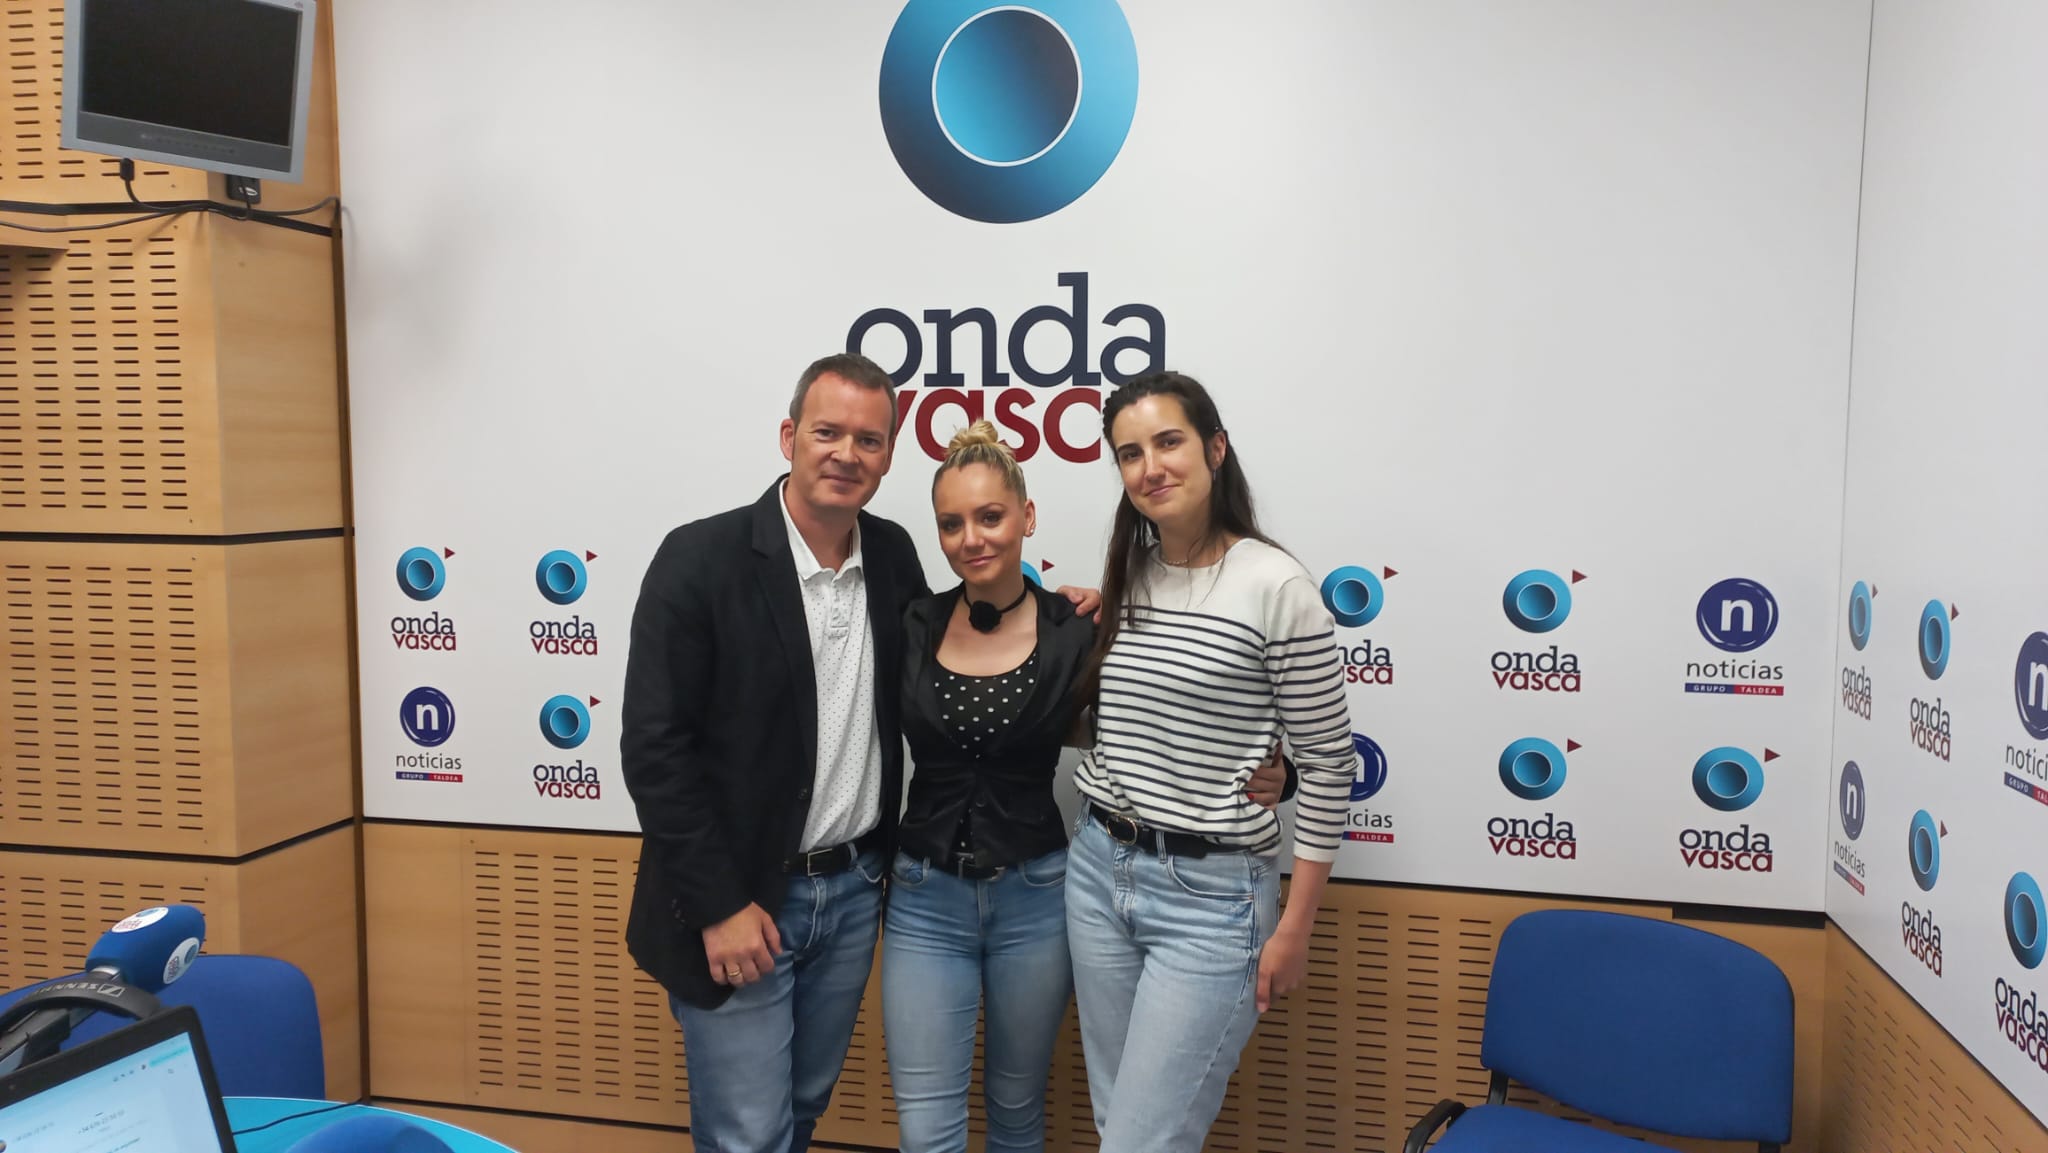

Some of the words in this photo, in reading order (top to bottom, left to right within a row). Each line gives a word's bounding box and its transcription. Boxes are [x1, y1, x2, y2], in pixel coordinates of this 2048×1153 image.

[846, 271, 1167, 388] onda
[891, 387, 1102, 464] asc
[391, 611, 456, 635] onda
[530, 615, 597, 639] onda
[392, 633, 457, 651] vasca
[531, 637, 598, 656] vasca
[1337, 639, 1393, 667] nda
[1491, 645, 1581, 674] onda
[1686, 659, 1784, 681] noticias
[1340, 665, 1393, 685] sca
[1492, 670, 1582, 692] vasca
[1842, 665, 1871, 700] onda
[1693, 684, 1726, 693] GRUPO
[1740, 686, 1777, 695] TALDEA
[1842, 688, 1871, 720] vasca
[1910, 697, 1951, 738] onda
[1910, 720, 1951, 762] vasca
[396, 752, 462, 770] noticias
[532, 760, 600, 784] onda
[2005, 744, 2048, 781] notici
[433, 774, 459, 782] TALDEA
[534, 781, 601, 800] vasca
[1346, 808, 1393, 829] icias
[1487, 812, 1576, 841] onda
[1355, 833, 1388, 841] TALDEA
[1488, 835, 1576, 860] vasca
[1679, 824, 1772, 853] onda
[1680, 848, 1773, 873] vasca
[1834, 840, 1865, 878] noticias
[1901, 901, 1942, 953] onda
[1902, 924, 1942, 978] vasca
[1995, 977, 2048, 1046] onda
[1995, 1002, 2048, 1074] vasca
